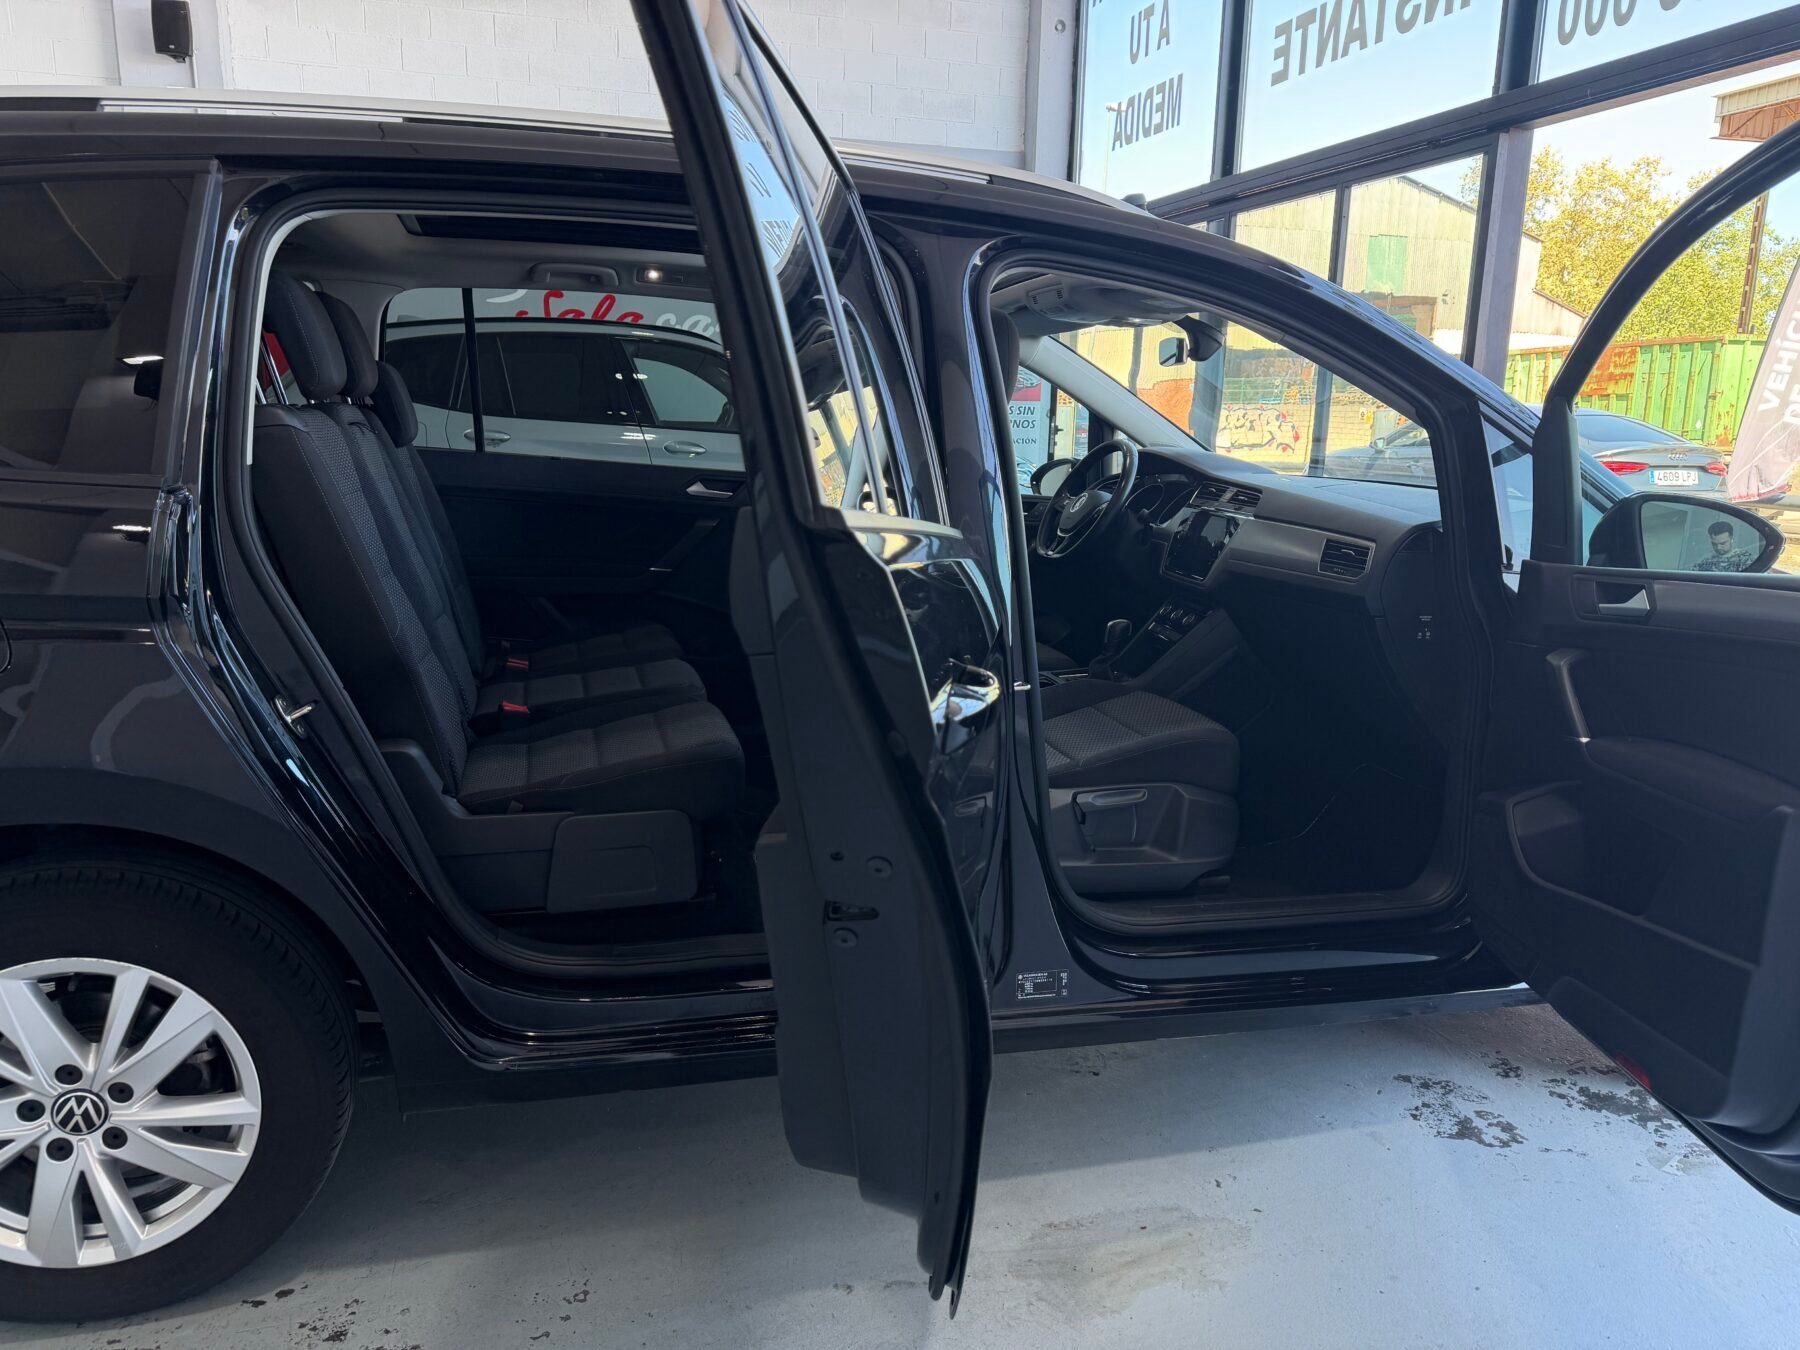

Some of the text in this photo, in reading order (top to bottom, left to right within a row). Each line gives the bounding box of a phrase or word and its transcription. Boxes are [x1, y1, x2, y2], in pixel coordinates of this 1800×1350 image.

[1758, 300, 1800, 412] VEHÍC
[1016, 405, 1036, 416] SIN
[1010, 419, 1037, 429] NOS
